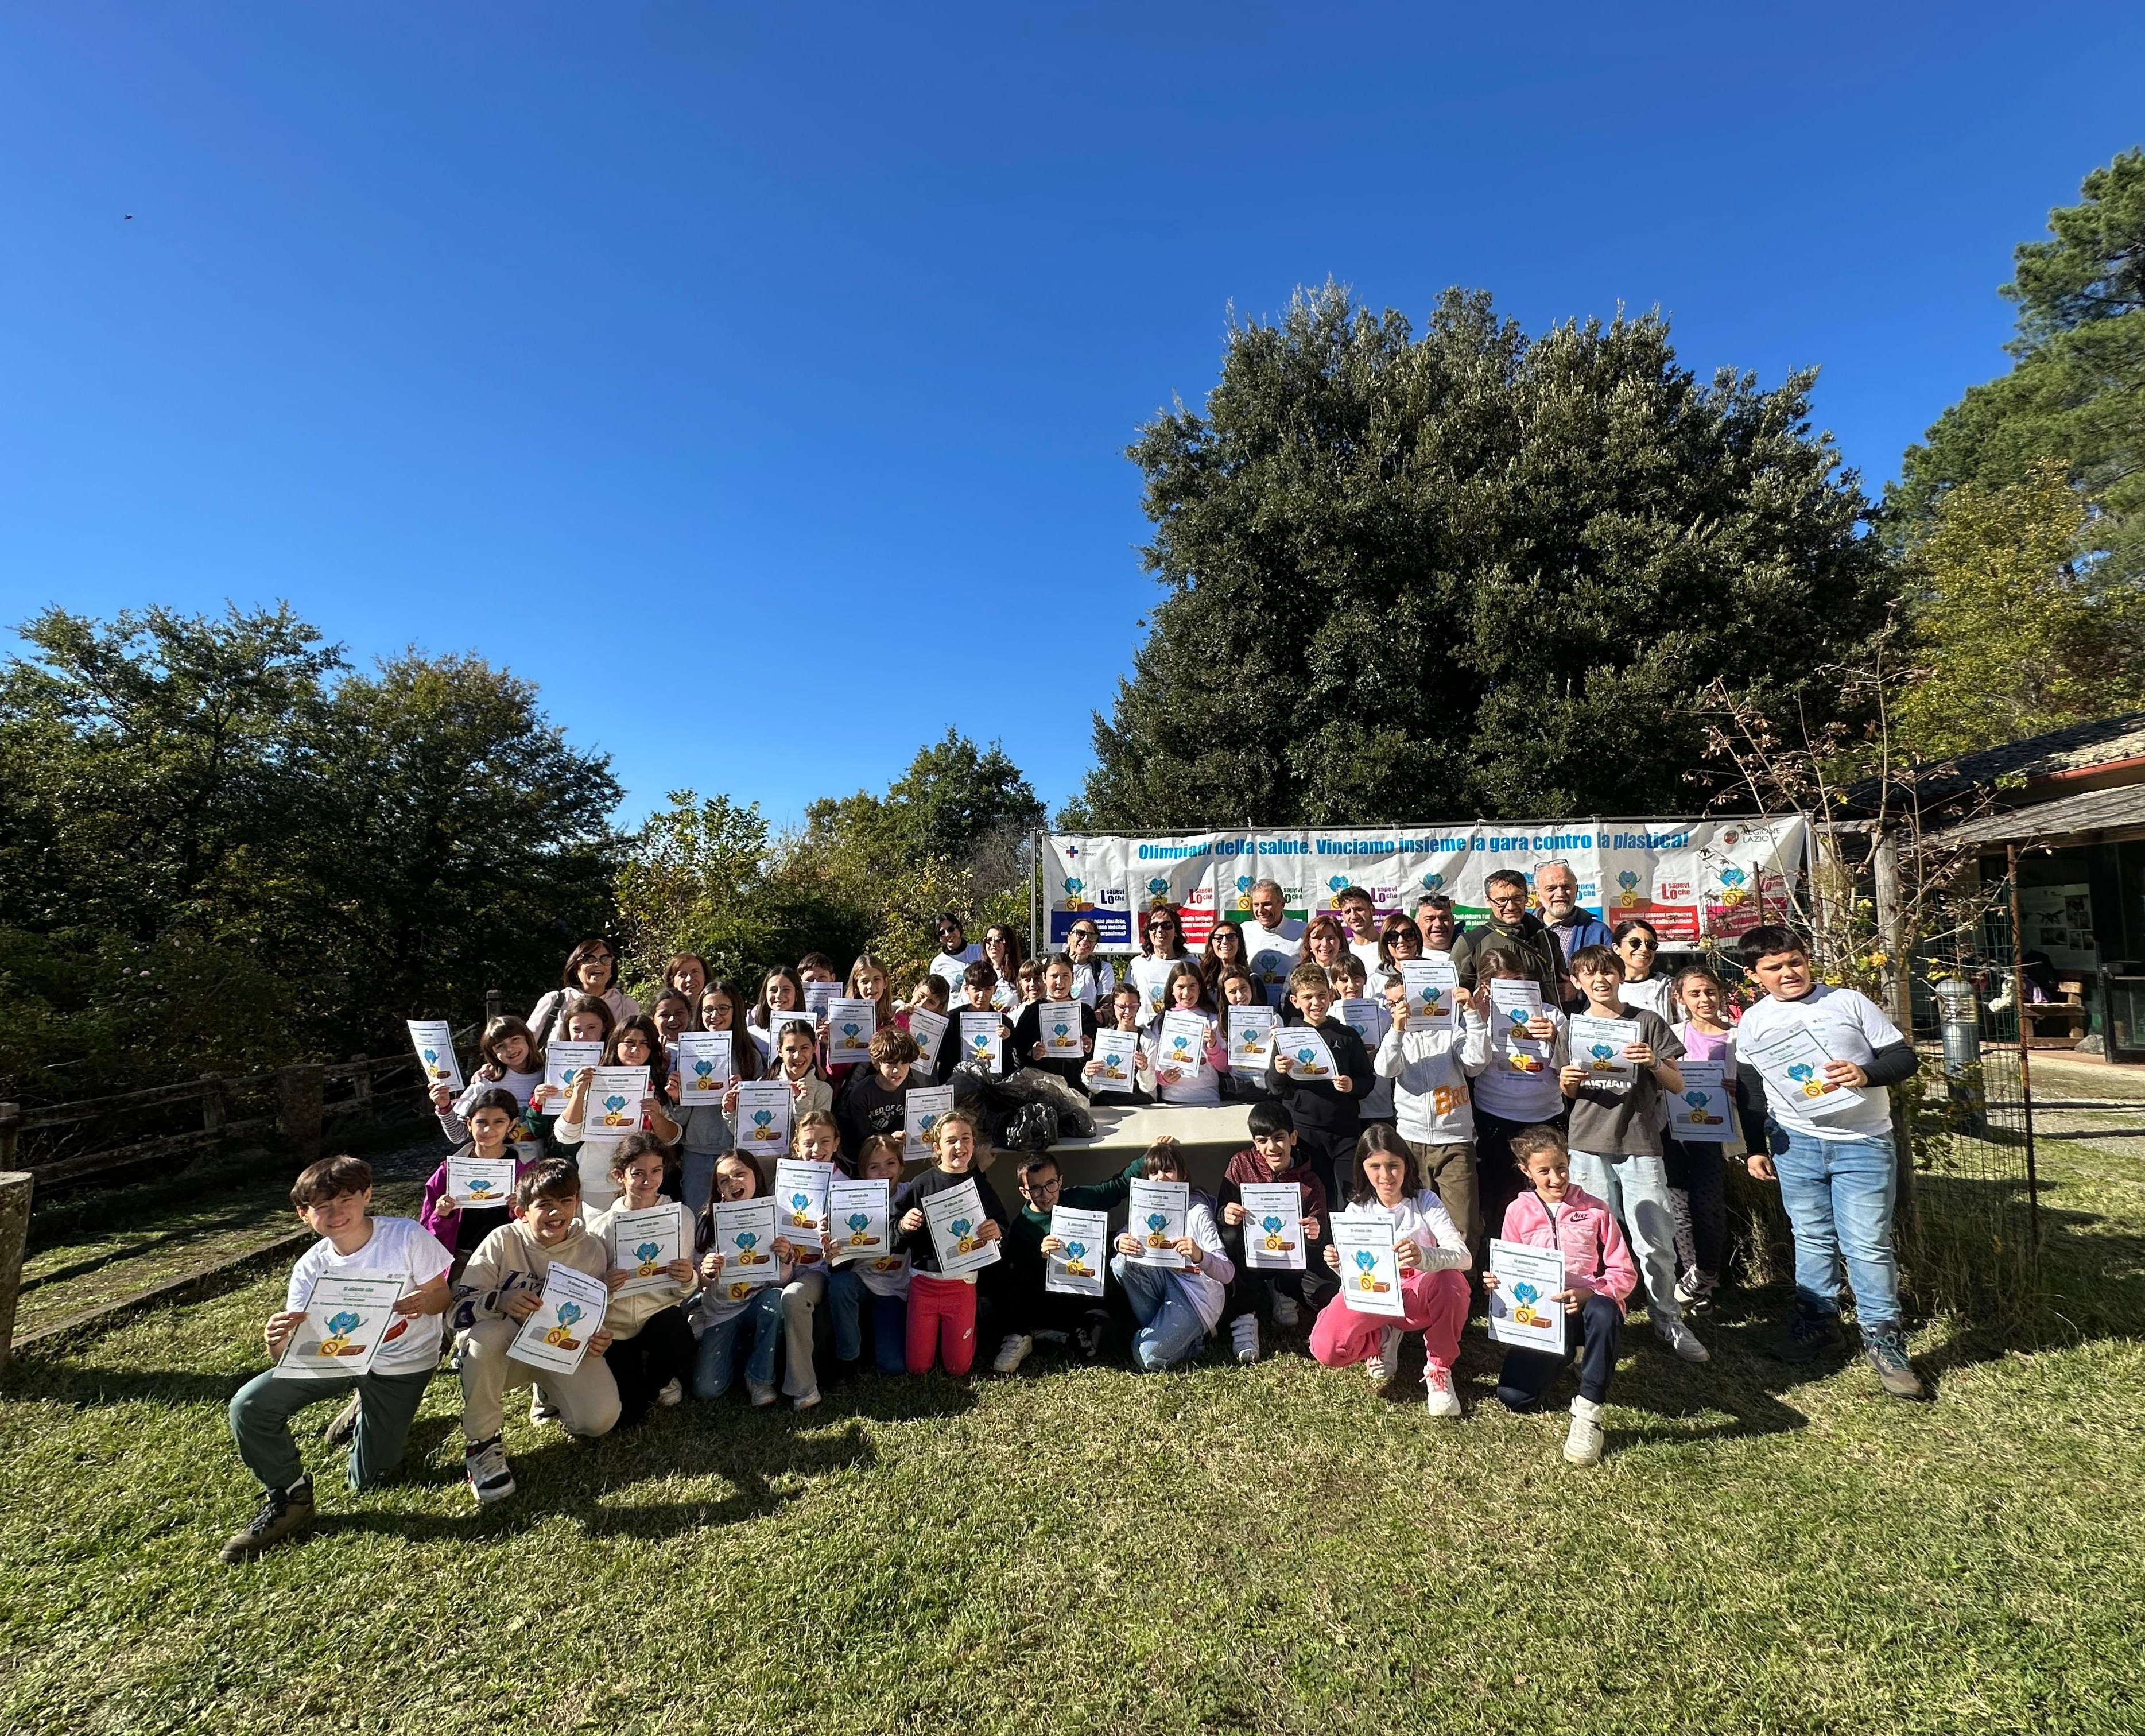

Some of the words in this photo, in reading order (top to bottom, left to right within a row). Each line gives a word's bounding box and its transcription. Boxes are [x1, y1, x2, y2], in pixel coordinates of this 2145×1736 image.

[1139, 841, 1212, 860] Olimpiadi
[1215, 839, 1255, 855] della
[1259, 839, 1313, 855] salute.
[1316, 839, 1395, 855] Vinciamo
[1398, 836, 1467, 854] insieme
[1470, 835, 1485, 851] la
[1490, 835, 1529, 853] gara
[1533, 834, 1592, 851] contro
[1597, 831, 1610, 848] la
[1614, 831, 1689, 850] plastica!
[1574, 1212, 1588, 1220] NIKE
